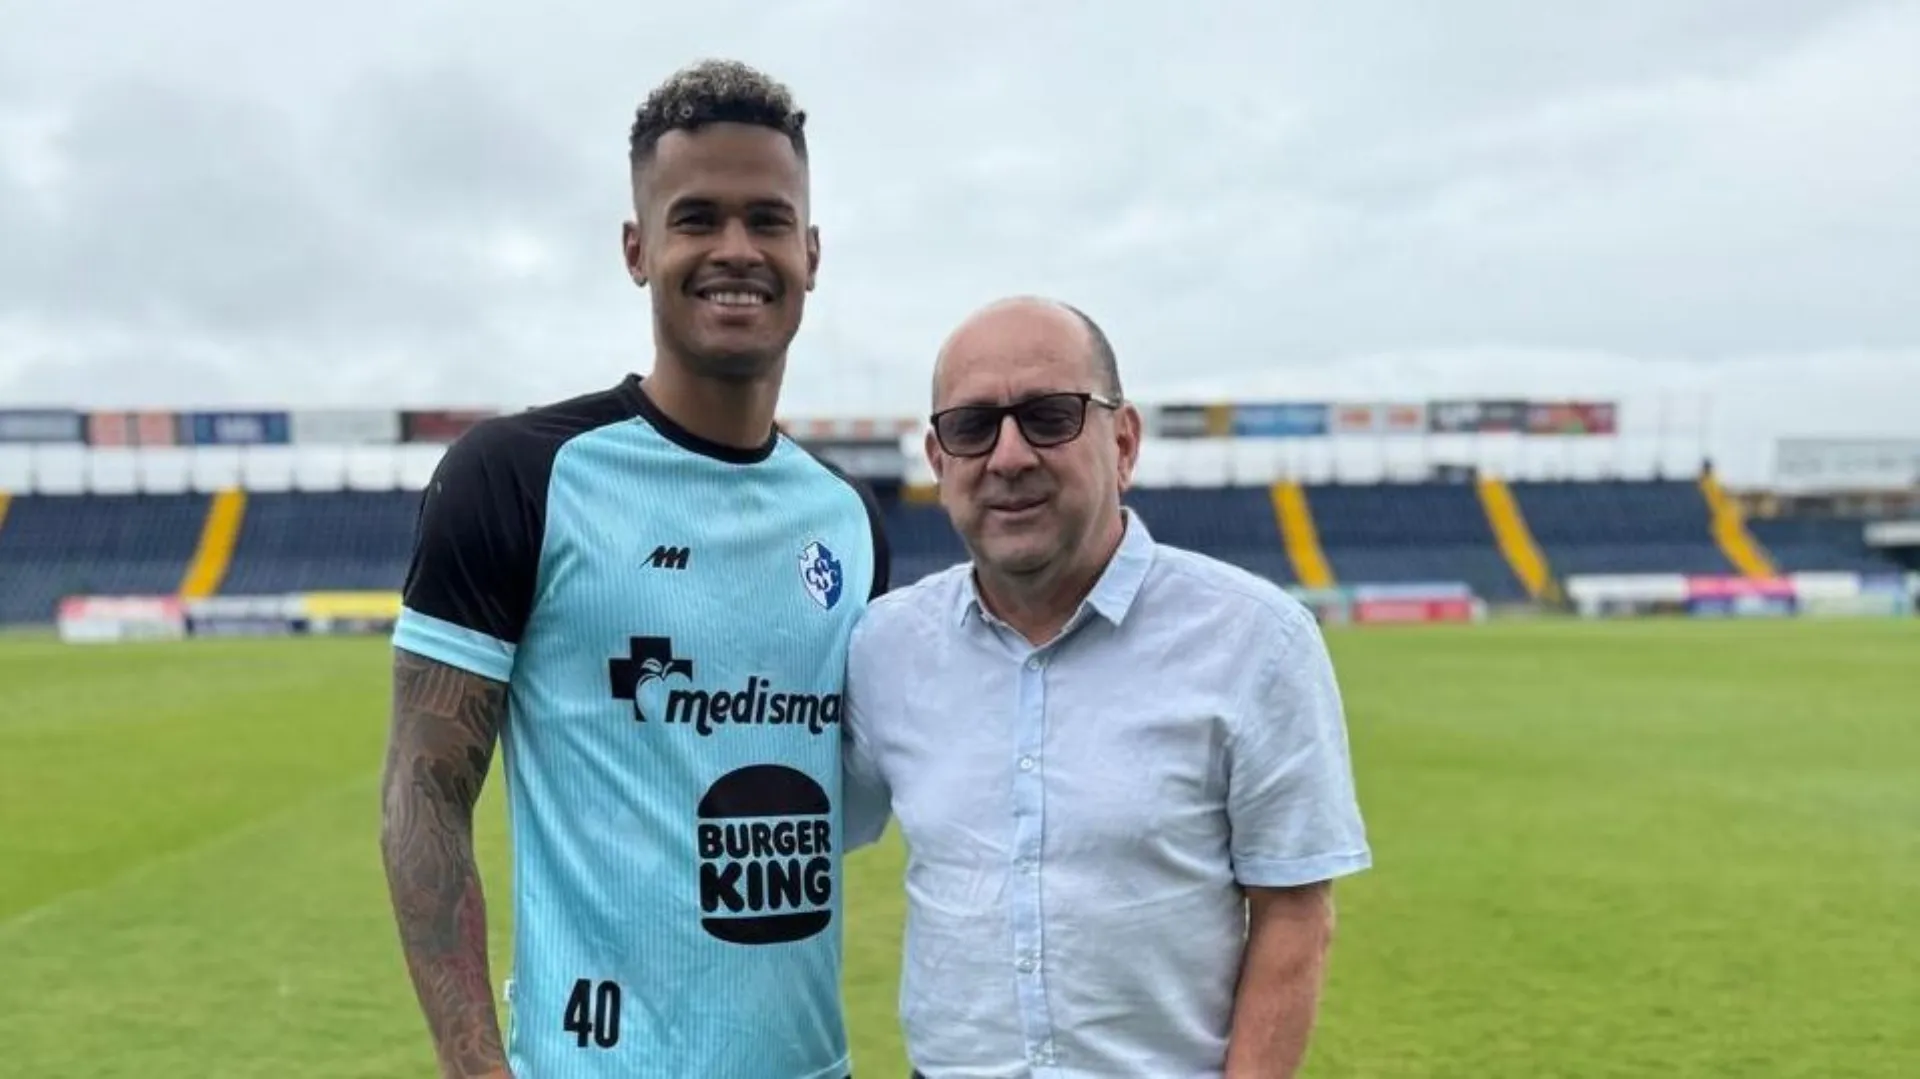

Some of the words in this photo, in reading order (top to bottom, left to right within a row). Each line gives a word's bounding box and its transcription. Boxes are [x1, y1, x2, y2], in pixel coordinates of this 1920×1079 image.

[664, 675, 841, 736] medisma
[697, 820, 832, 859] BURGER
[699, 857, 832, 913] KING
[563, 978, 621, 1049] 40
